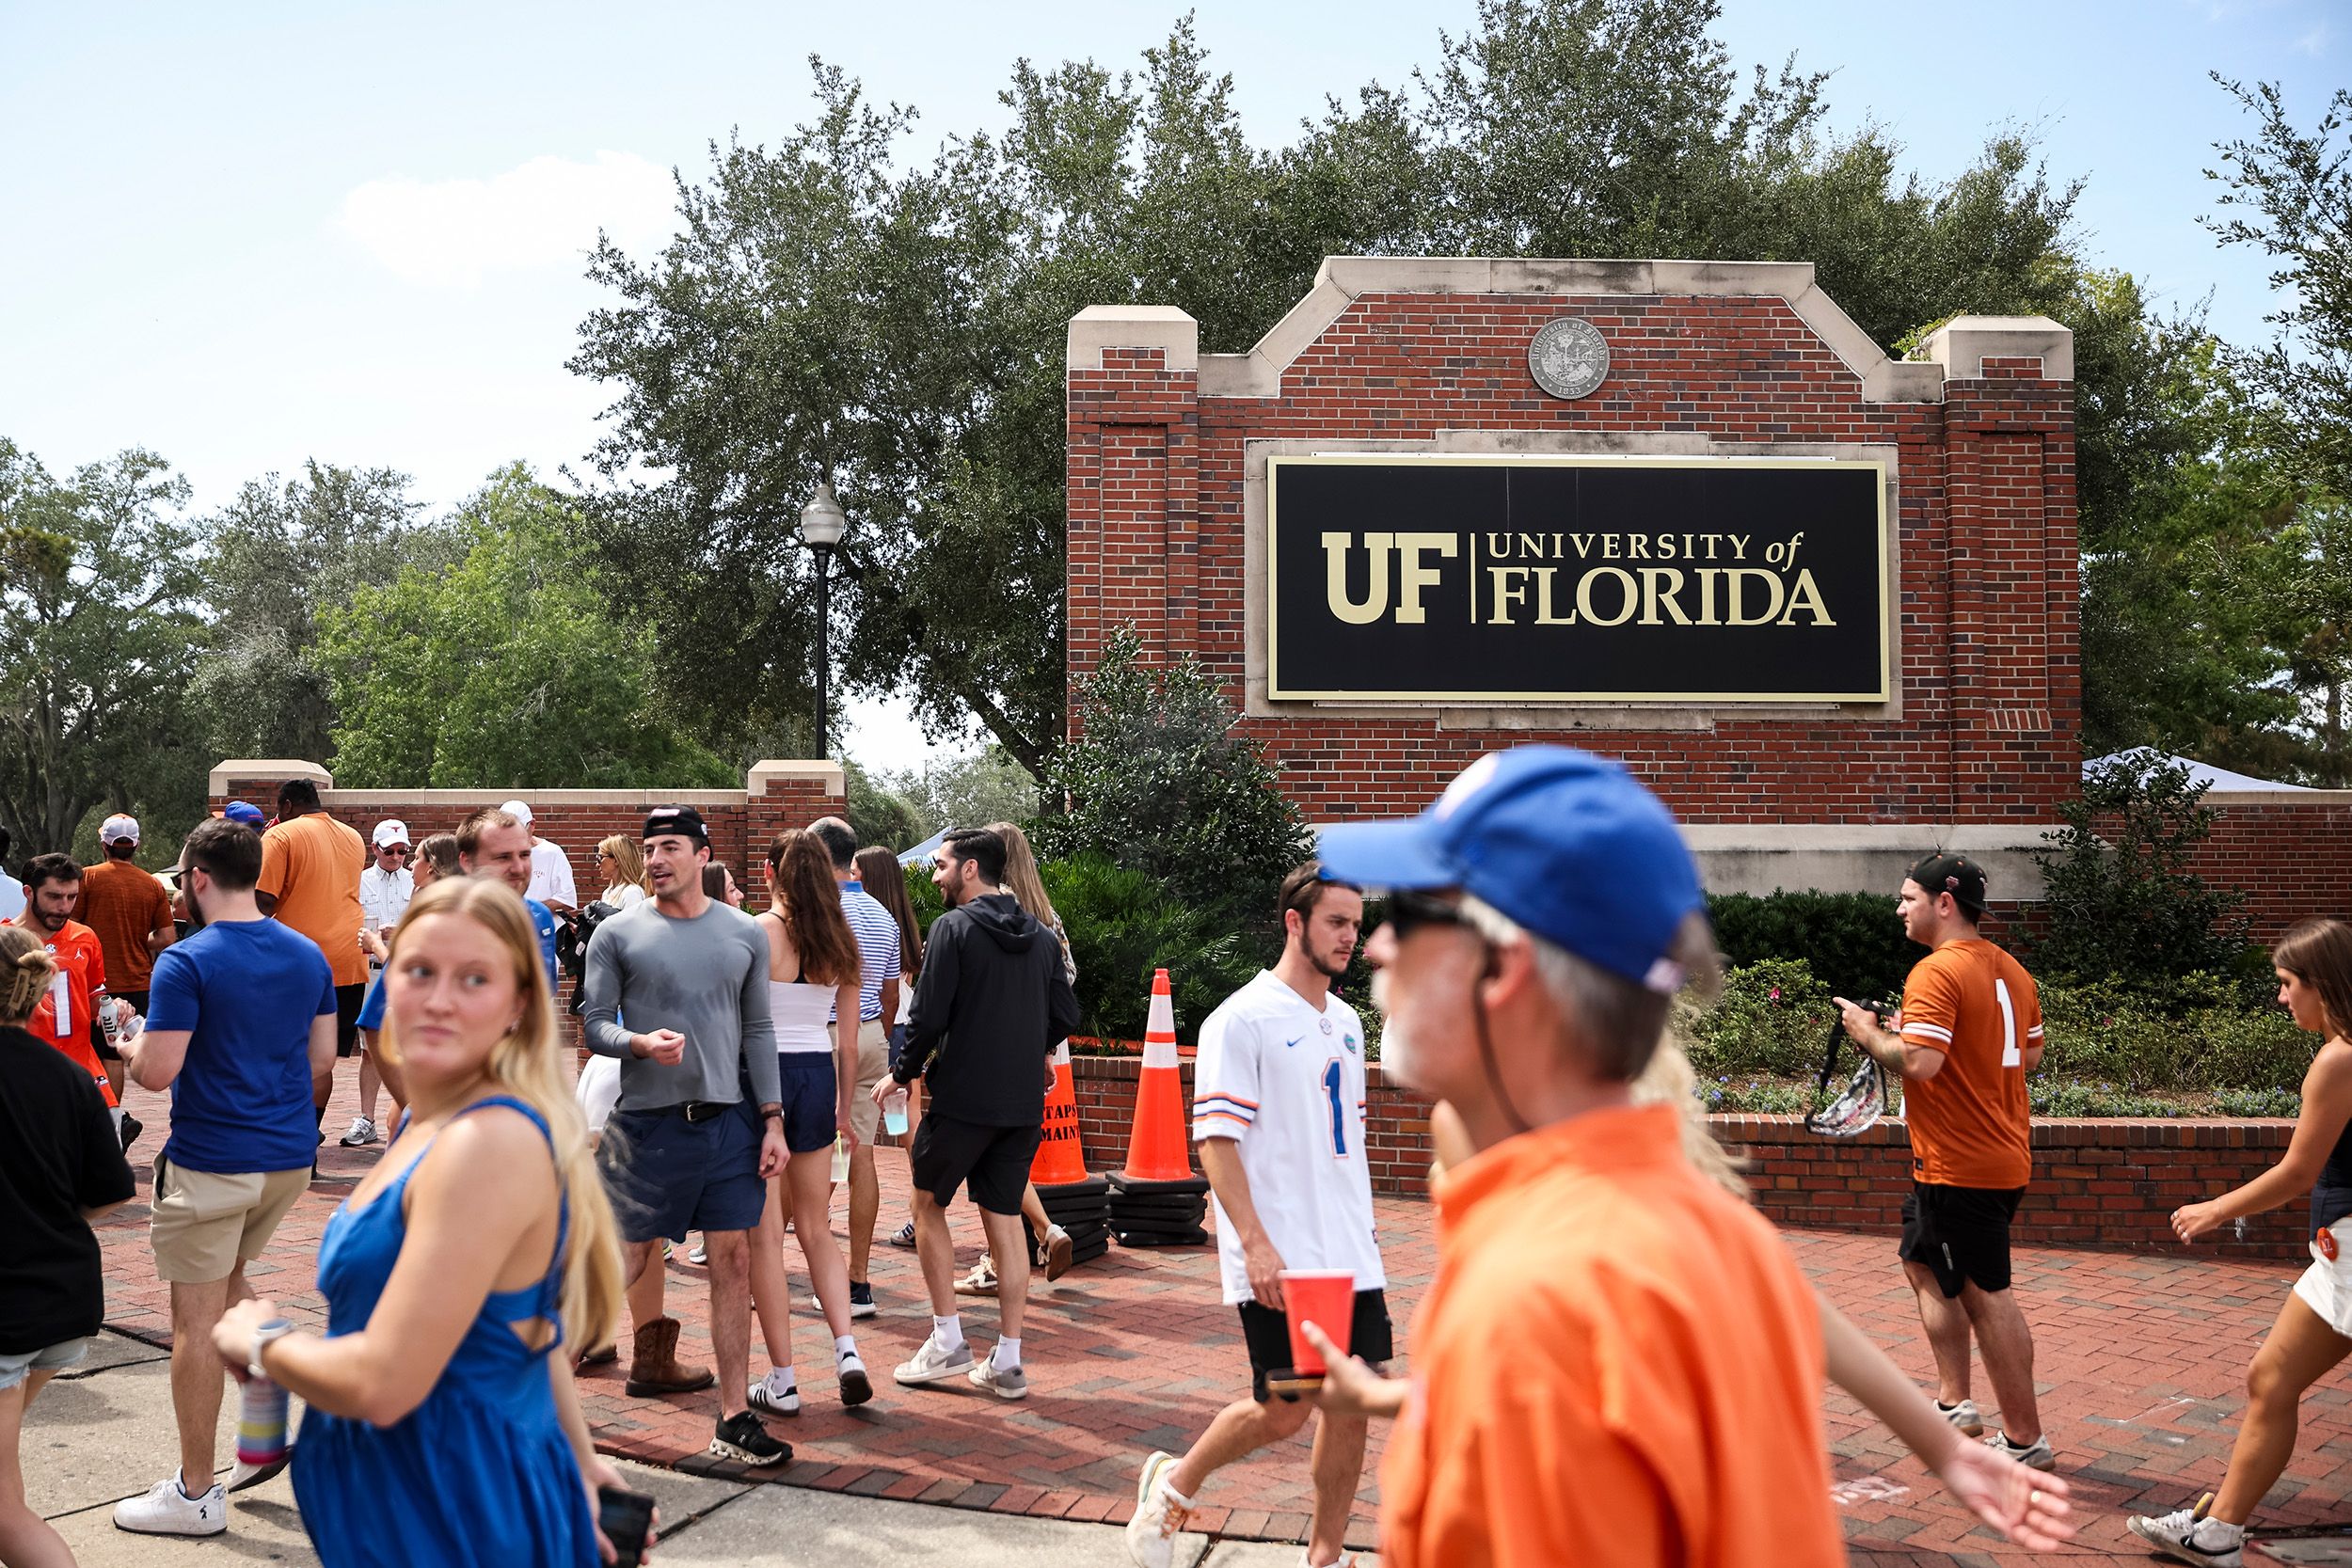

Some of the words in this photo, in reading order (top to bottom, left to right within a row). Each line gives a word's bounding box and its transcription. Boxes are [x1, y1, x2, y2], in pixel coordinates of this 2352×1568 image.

[1558, 387, 1581, 395] 1853
[1321, 531, 1457, 624] UF
[1486, 532, 1751, 560] UNIVERSITY
[1765, 531, 1804, 572] of
[1486, 566, 1837, 626] FLORIDA
[47, 969, 72, 1038] 1
[1994, 978, 2021, 1066] 1
[1321, 1057, 1349, 1159] 1
